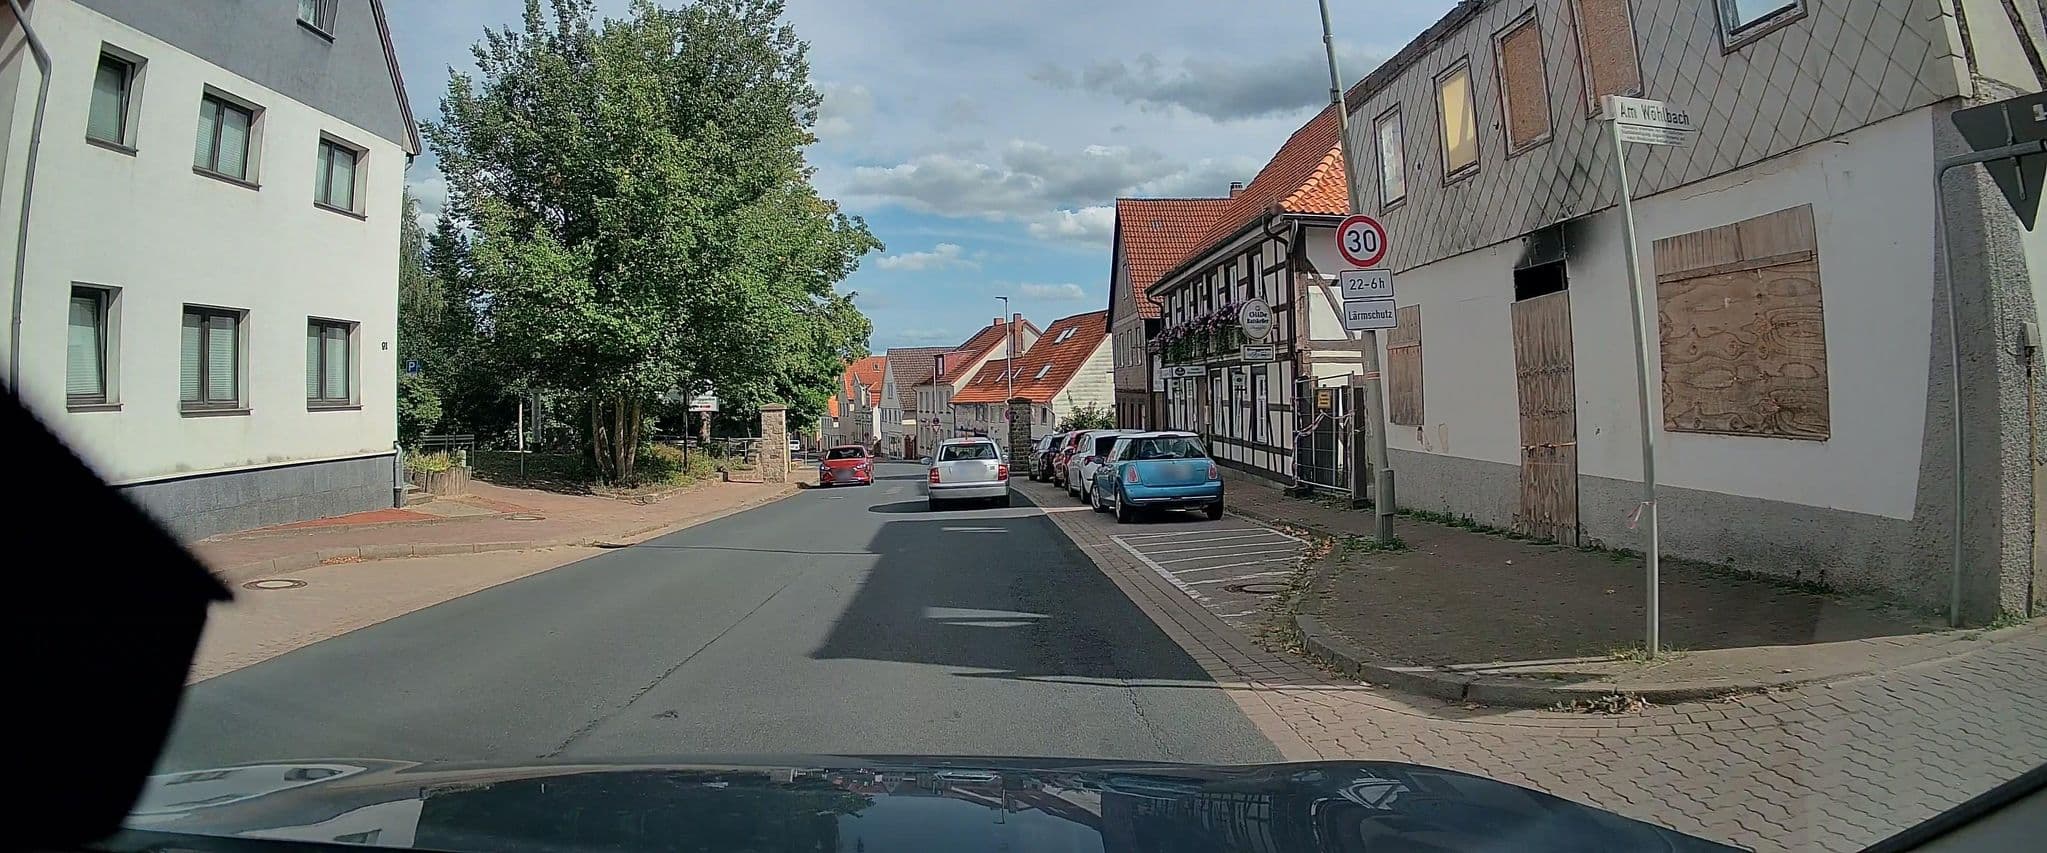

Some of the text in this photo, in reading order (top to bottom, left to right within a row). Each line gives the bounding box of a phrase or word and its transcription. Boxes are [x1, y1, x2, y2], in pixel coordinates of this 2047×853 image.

[1620, 102, 1690, 125] Am Wöhlbach
[1347, 229, 1377, 253] 30
[1348, 310, 1393, 321] Lärmschutz
